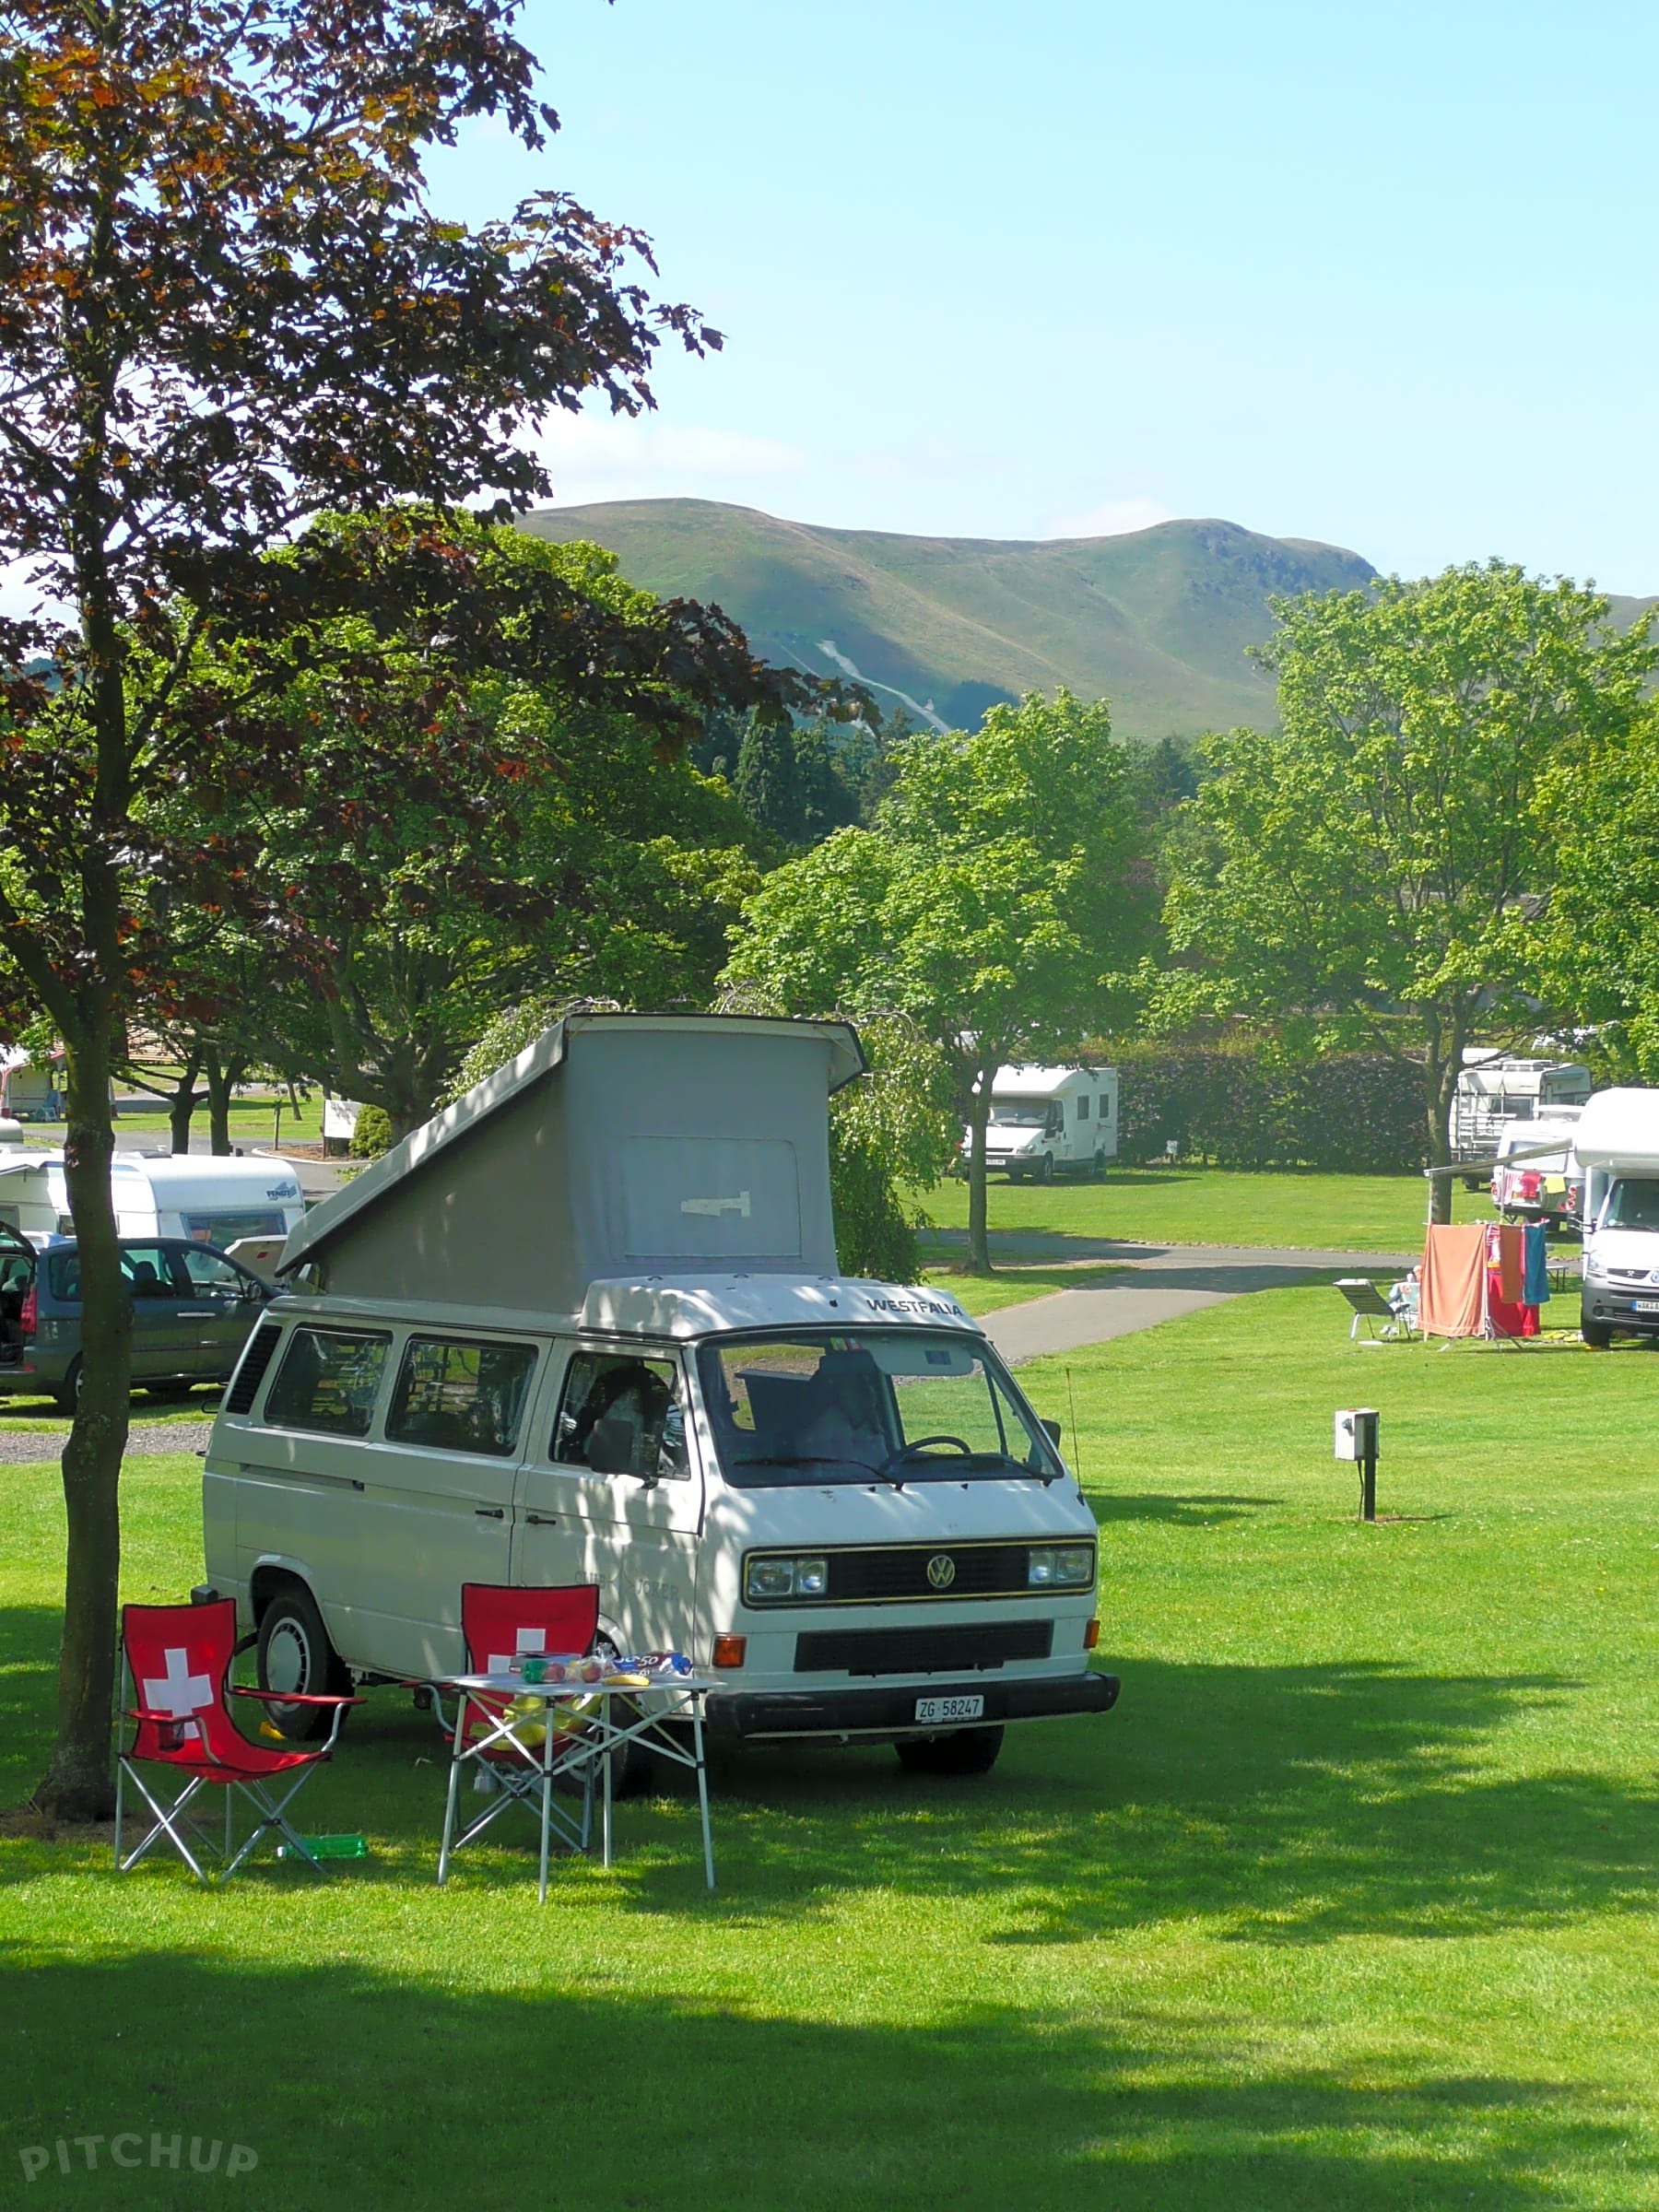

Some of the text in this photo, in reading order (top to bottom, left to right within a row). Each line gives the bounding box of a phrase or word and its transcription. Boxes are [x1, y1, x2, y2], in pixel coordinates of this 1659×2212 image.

[866, 1299, 963, 1316] WESTFALIA
[927, 1555, 955, 1588] VW
[636, 1577, 679, 1601] JOKER
[920, 1699, 980, 1717] ZG 58247
